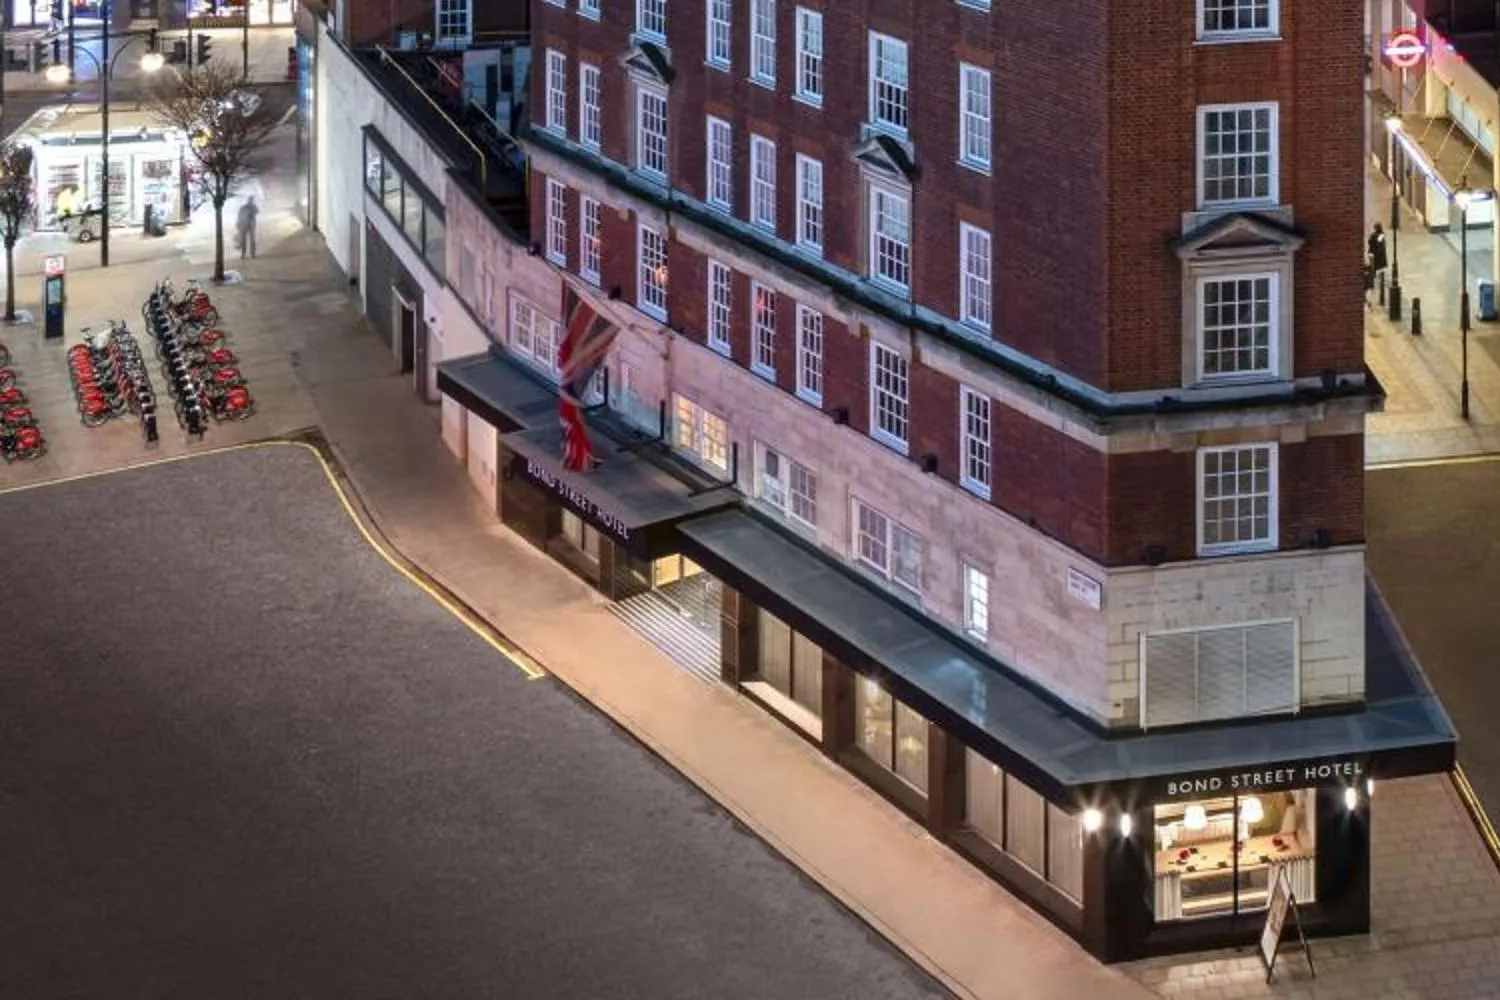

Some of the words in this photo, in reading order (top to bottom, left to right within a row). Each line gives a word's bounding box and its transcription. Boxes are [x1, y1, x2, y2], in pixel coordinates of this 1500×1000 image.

[1167, 777, 1223, 795] BOND
[1231, 769, 1296, 789] STREET
[1305, 761, 1363, 780] HOTEL
